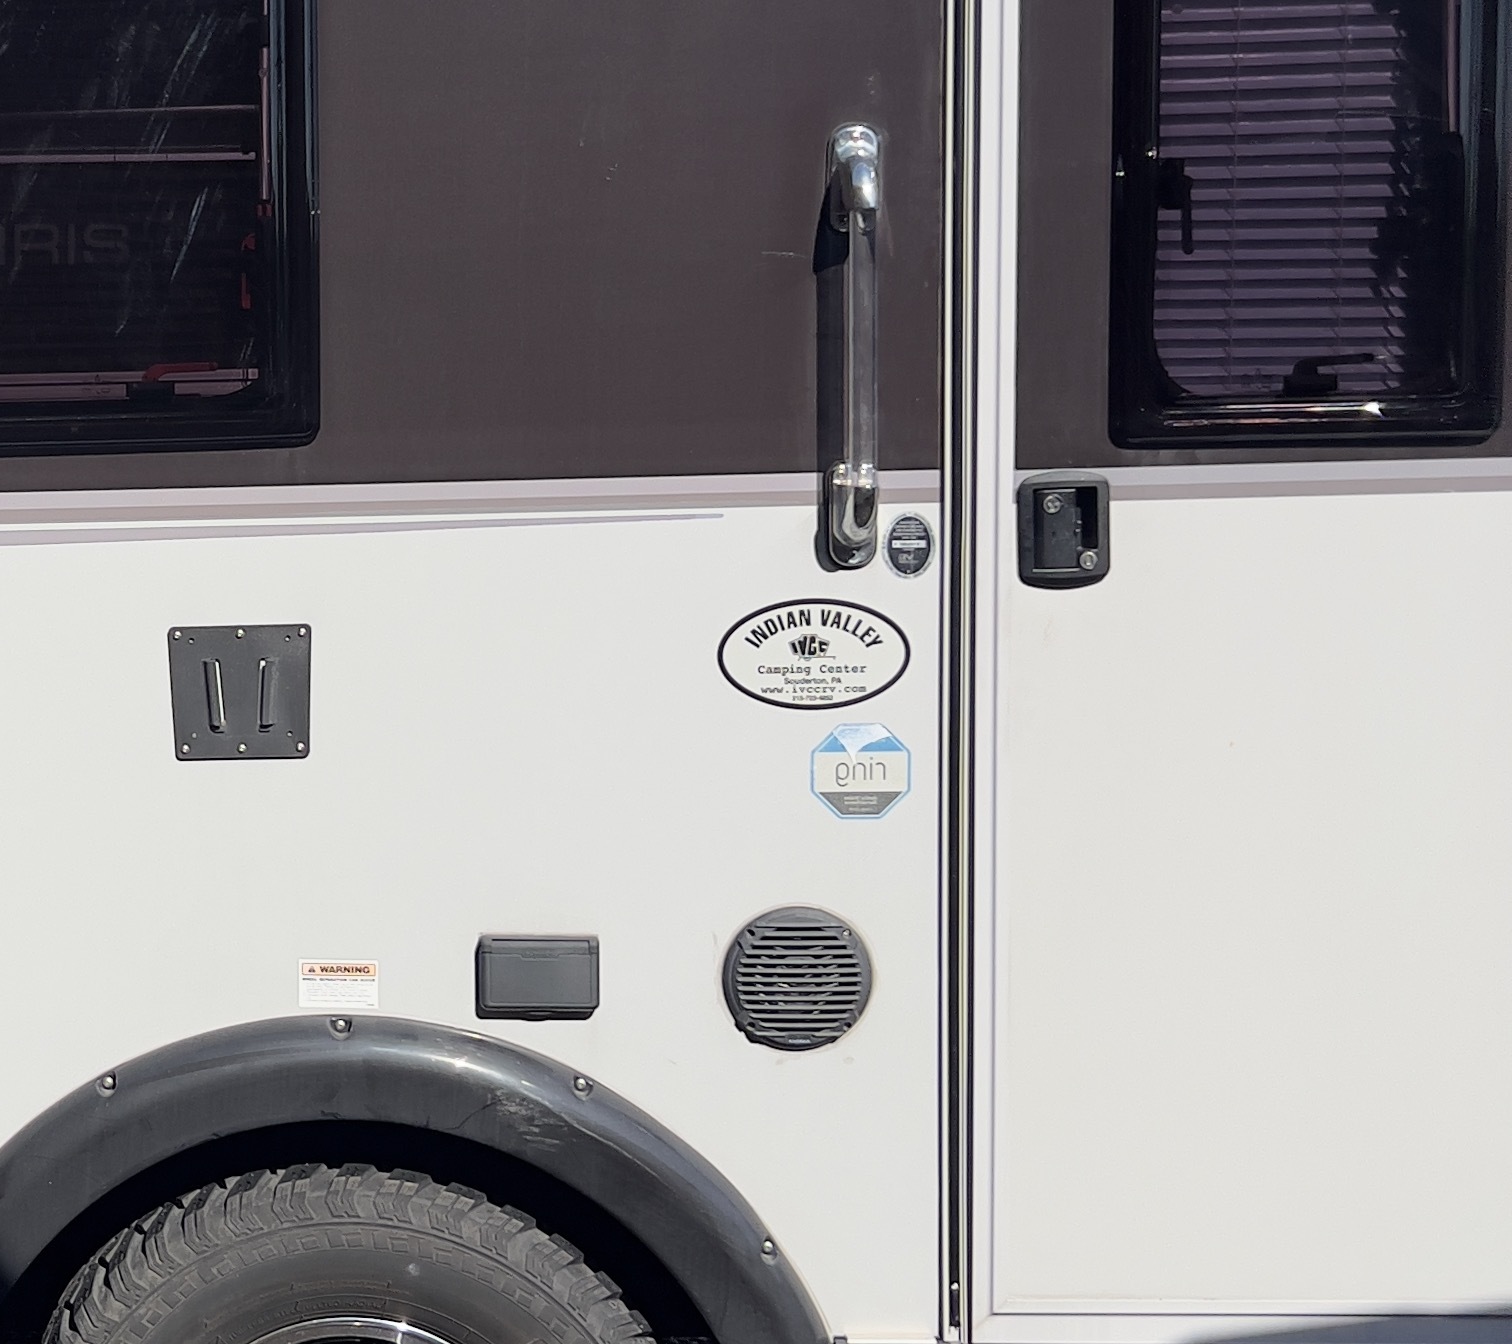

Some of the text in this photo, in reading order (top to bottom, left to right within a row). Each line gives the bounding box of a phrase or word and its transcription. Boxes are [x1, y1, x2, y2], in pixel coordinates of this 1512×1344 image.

[744, 609, 883, 649] INDIAN VALLEY
[758, 664, 867, 676] Camping Center
[831, 677, 842, 685] PA
[761, 685, 867, 694] www.ivccrv.com
[319, 966, 370, 974] WARNING
